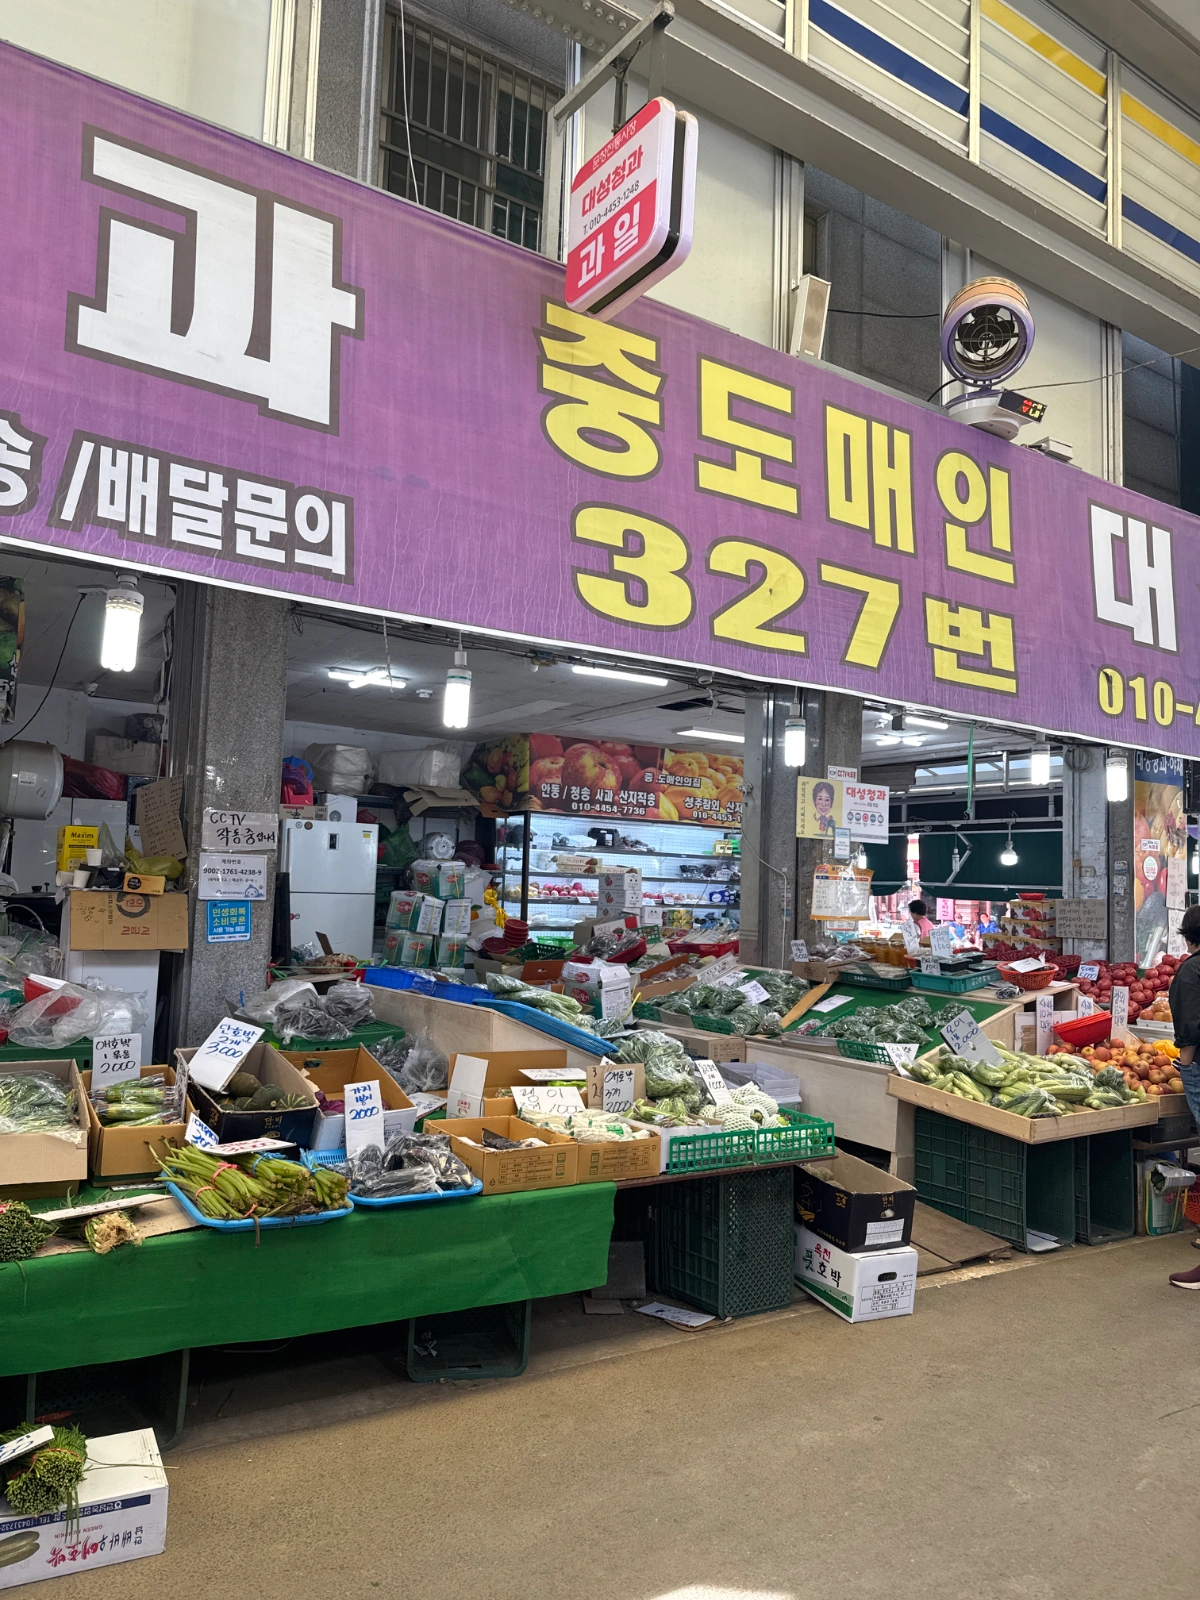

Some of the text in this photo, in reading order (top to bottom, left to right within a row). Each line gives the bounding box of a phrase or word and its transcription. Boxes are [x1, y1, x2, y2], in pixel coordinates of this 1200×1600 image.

[581, 145, 643, 217] 대성청과
[589, 180, 640, 229] 010-4453-1248
[577, 201, 641, 289] 과일
[77, 136, 357, 425] 과
[542, 302, 1016, 586] 중도매인
[1090, 504, 1178, 651] 대
[571, 507, 1018, 697] 327번
[1099, 668, 1200, 726] 010-
[570, 785, 591, 801] 청송
[595, 789, 614, 803] 사과
[618, 791, 656, 807] 산지직송
[846, 786, 887, 802] 대성청과
[571, 802, 646, 816] 010-4454-7736
[684, 796, 720, 812] 성주참외
[210, 812, 246, 826] CCTV
[203, 867, 262, 876] 9002-1761-4238-9
[212, 907, 246, 917] 민생회복
[212, 916, 246, 927] 소비쿠폰
[121, 925, 150, 936] 시금치
[219, 1024, 258, 1043] 단호박
[95, 1037, 132, 1050] 애호박
[100, 1061, 136, 1075] 2000
[604, 1070, 634, 1084] 애호박
[350, 1085, 371, 1095] 가지
[519, 1087, 564, 1103] 팽이
[350, 1107, 379, 1120] 2000
[605, 1100, 632, 1114] 2000
[814, 1243, 831, 1263] 옥천
[46, 1535, 100, 1568] 애호박
